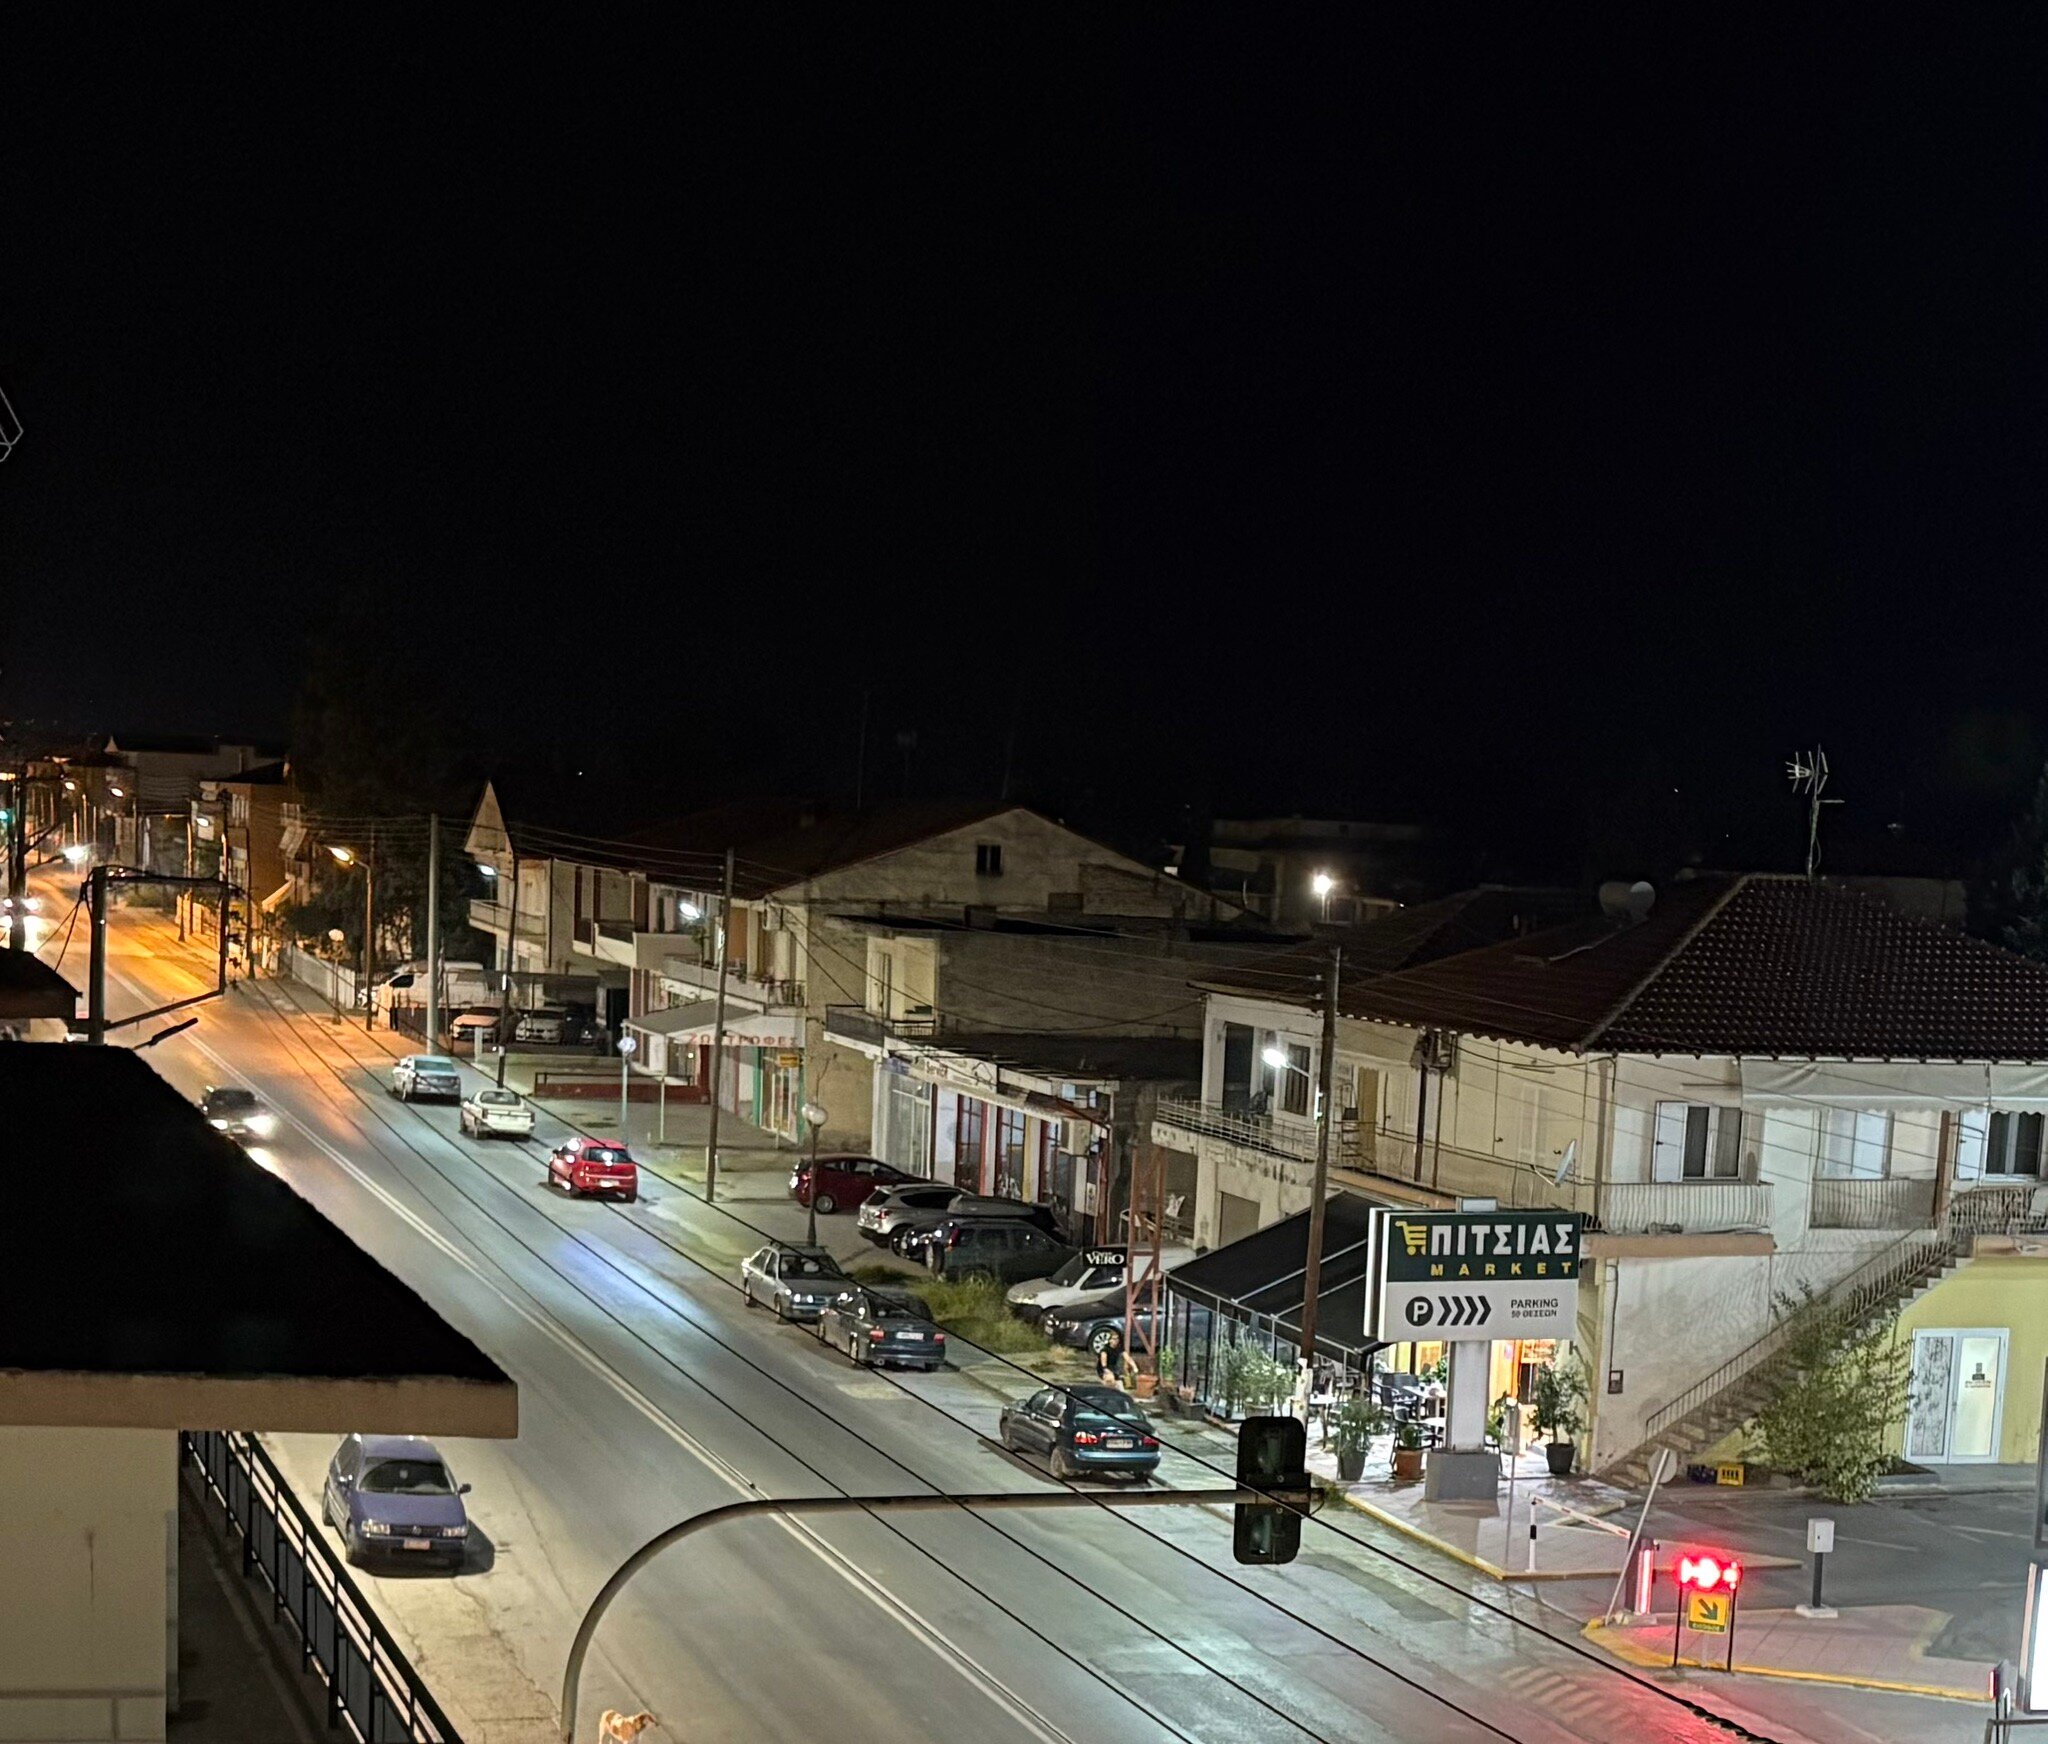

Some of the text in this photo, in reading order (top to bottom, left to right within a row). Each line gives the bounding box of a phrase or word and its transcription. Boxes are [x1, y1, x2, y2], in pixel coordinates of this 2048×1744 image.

[689, 1032, 798, 1047] ΖΩΤΡΟΦΕΣ
[1431, 1224, 1573, 1256] ΠΙΤΣΙΑΣ
[1430, 1262, 1572, 1276] MARKET
[1511, 1298, 1559, 1309] PARKING
